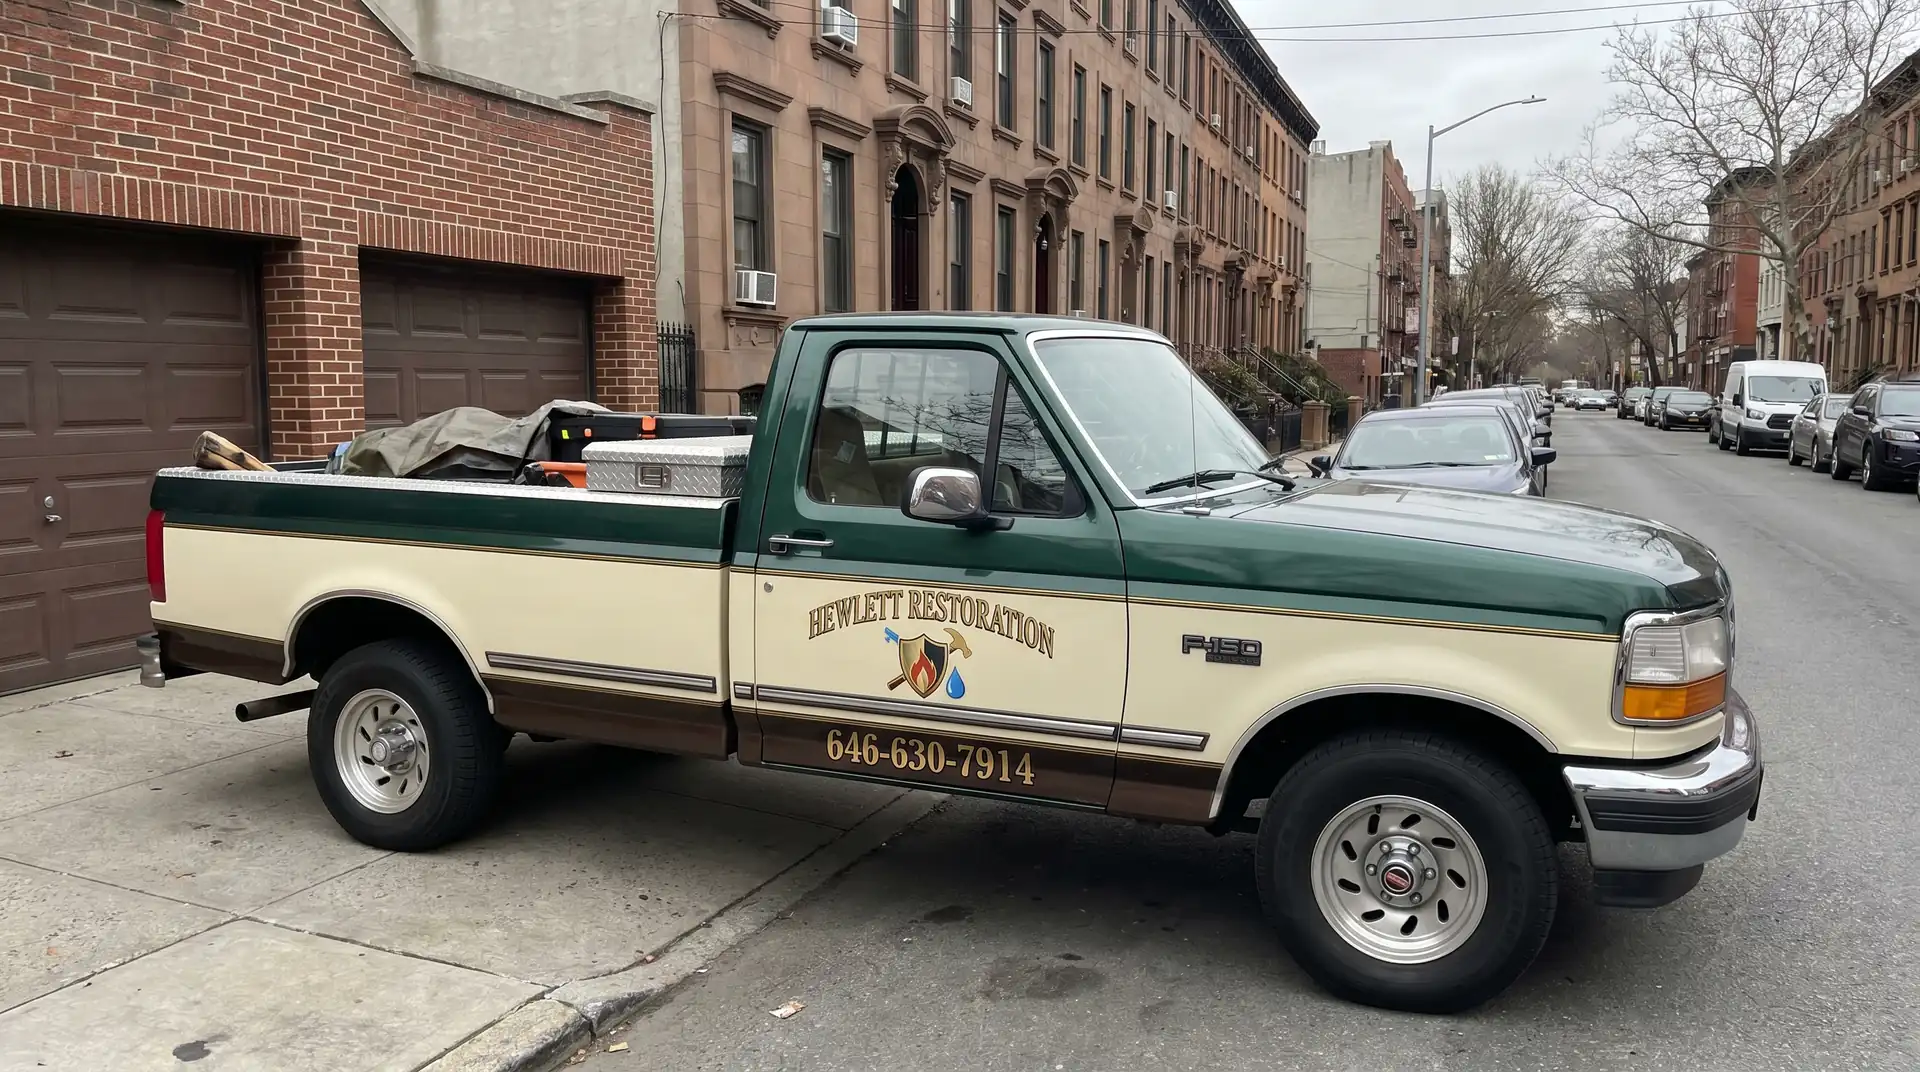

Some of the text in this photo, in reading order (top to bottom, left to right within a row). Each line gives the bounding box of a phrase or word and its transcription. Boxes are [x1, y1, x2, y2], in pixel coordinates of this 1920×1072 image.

[808, 589, 1055, 659] HEWLETT RESTORATION
[1182, 634, 1262, 657] F-150
[826, 729, 1035, 785] 646-630-7914
